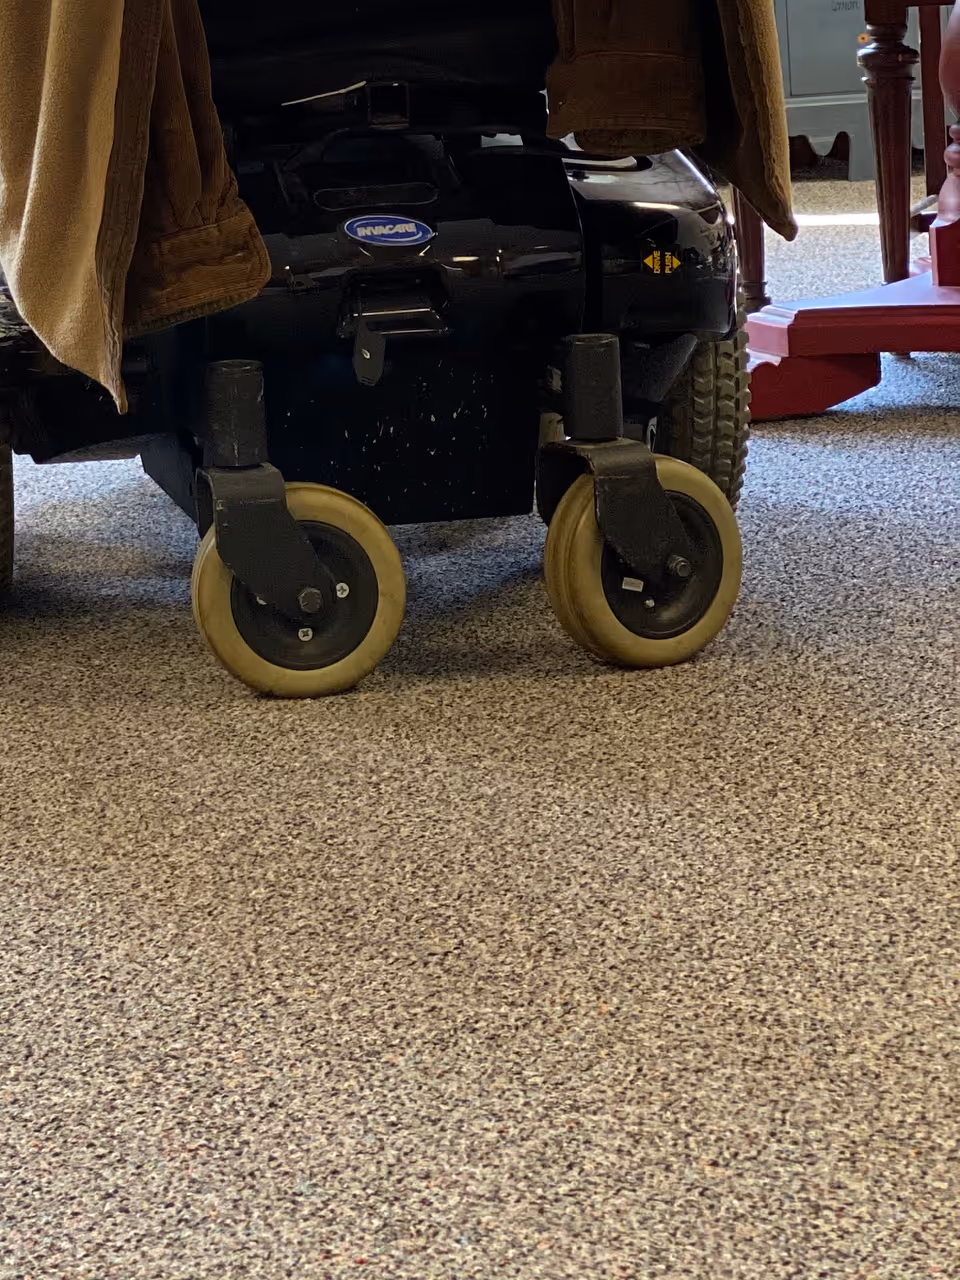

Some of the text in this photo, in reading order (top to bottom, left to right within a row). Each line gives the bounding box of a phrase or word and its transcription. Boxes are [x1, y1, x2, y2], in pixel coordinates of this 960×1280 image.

[356, 222, 417, 237] INVACARE
[653, 250, 661, 274] DRIVE
[664, 251, 672, 274] PUSH
